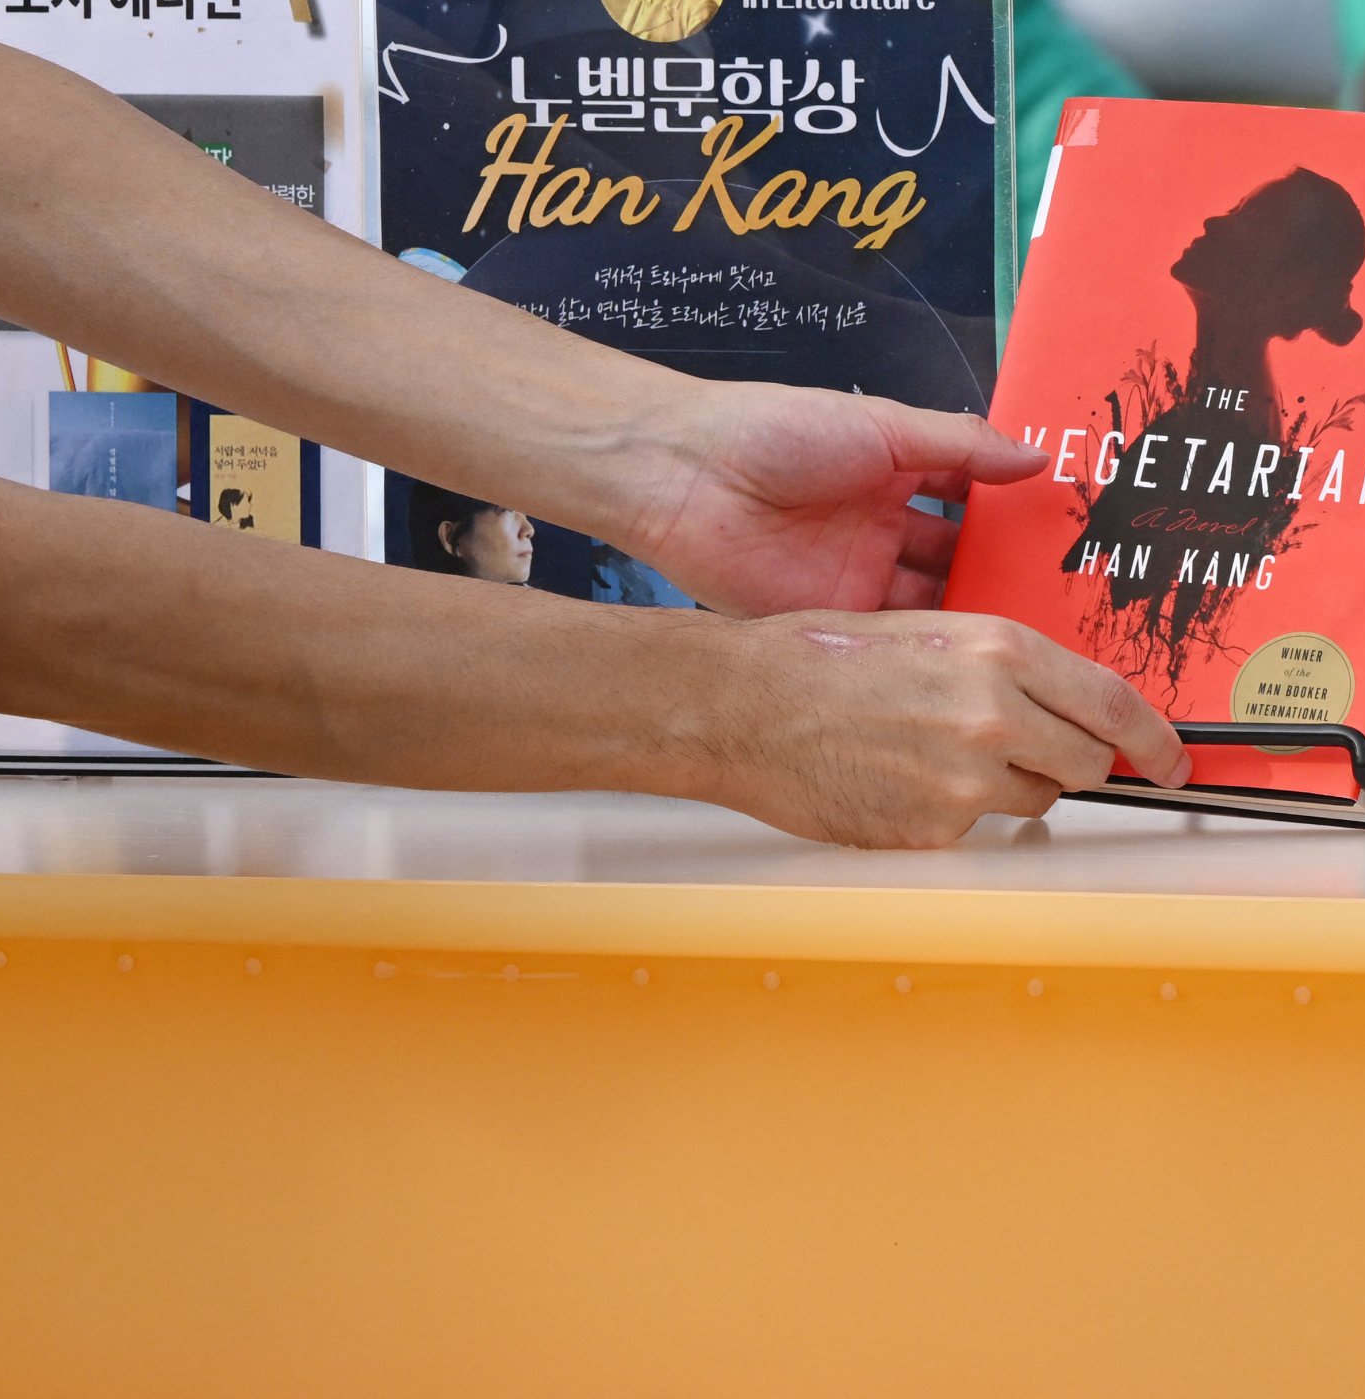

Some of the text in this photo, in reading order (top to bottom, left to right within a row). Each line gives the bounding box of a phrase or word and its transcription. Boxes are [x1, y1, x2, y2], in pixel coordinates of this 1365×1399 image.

[511, 57, 866, 134] 노벨문학상
[462, 113, 927, 249] Han Kang
[595, 265, 777, 294] 역사적 트라우마에 맞서고
[597, 300, 669, 330] 연약함을
[671, 306, 736, 329] 드러내는
[737, 299, 790, 331] 강렬한
[795, 303, 829, 331] 시적
[1205, 387, 1250, 411] THE
[1131, 507, 1259, 536] A Novel
[1079, 541, 1277, 591] HAN KANG
[1281, 647, 1323, 663] WINNER
[1283, 667, 1311, 678] of the
[1258, 682, 1328, 701] MAN BOOKER
[1245, 702, 1329, 722] INTERNATIONAL
